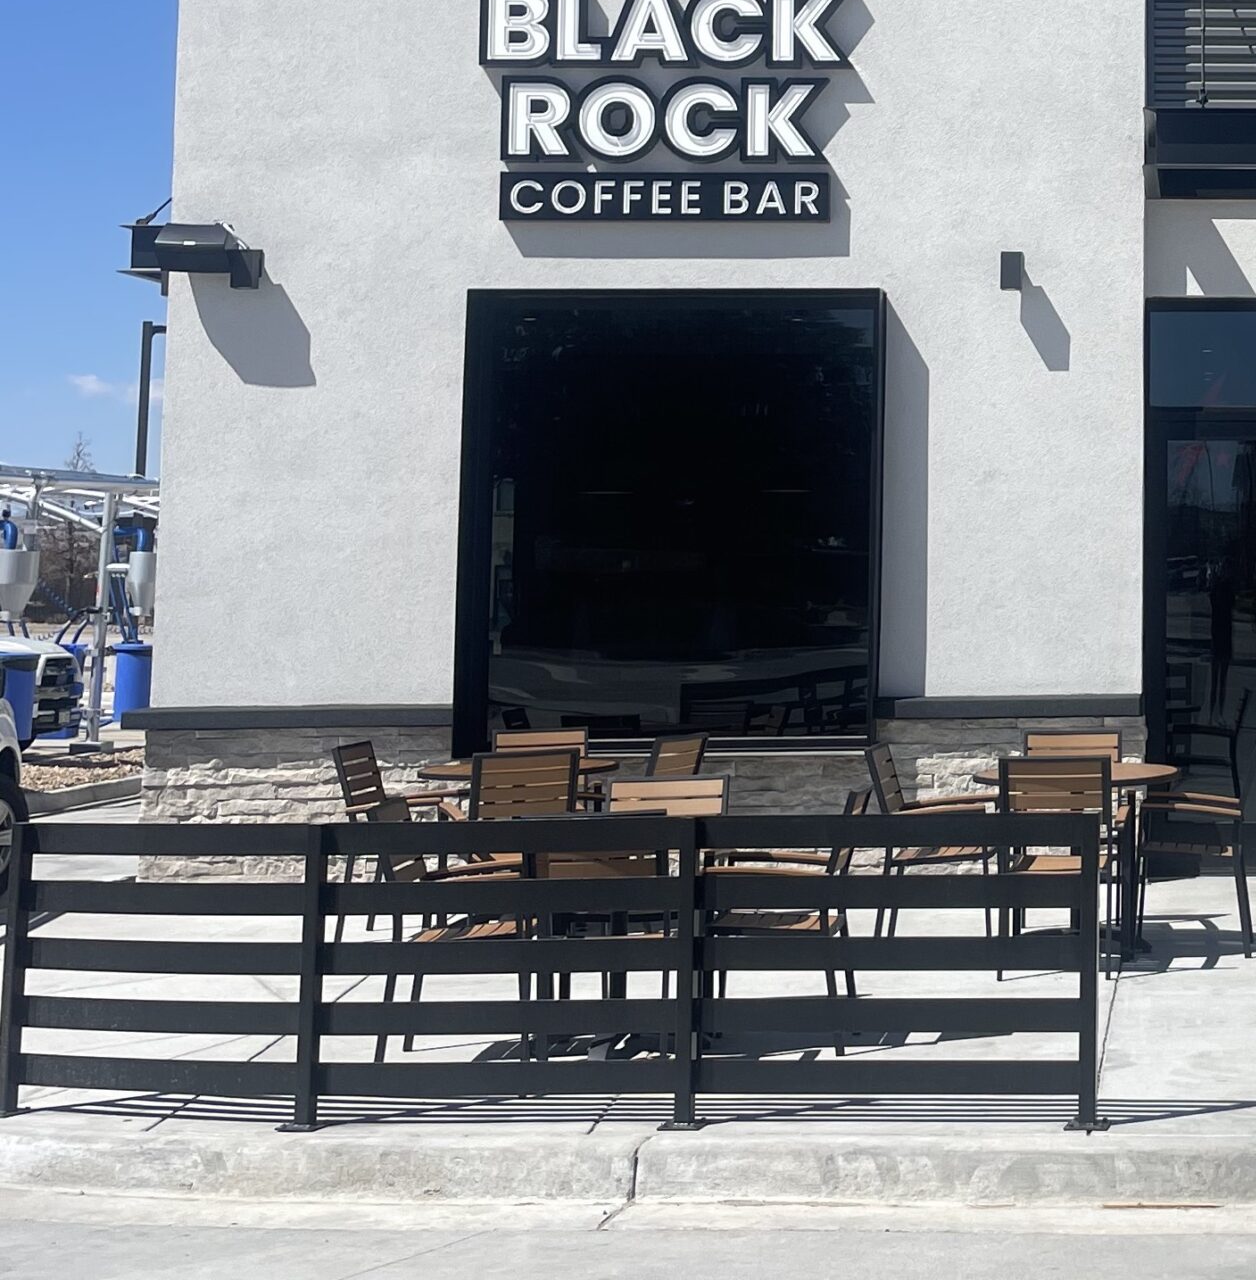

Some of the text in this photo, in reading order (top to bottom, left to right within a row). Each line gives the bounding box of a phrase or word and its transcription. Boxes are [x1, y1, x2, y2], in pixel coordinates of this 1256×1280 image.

[506, 81, 817, 158] ROCK
[508, 178, 820, 216] COFFEE BAR
